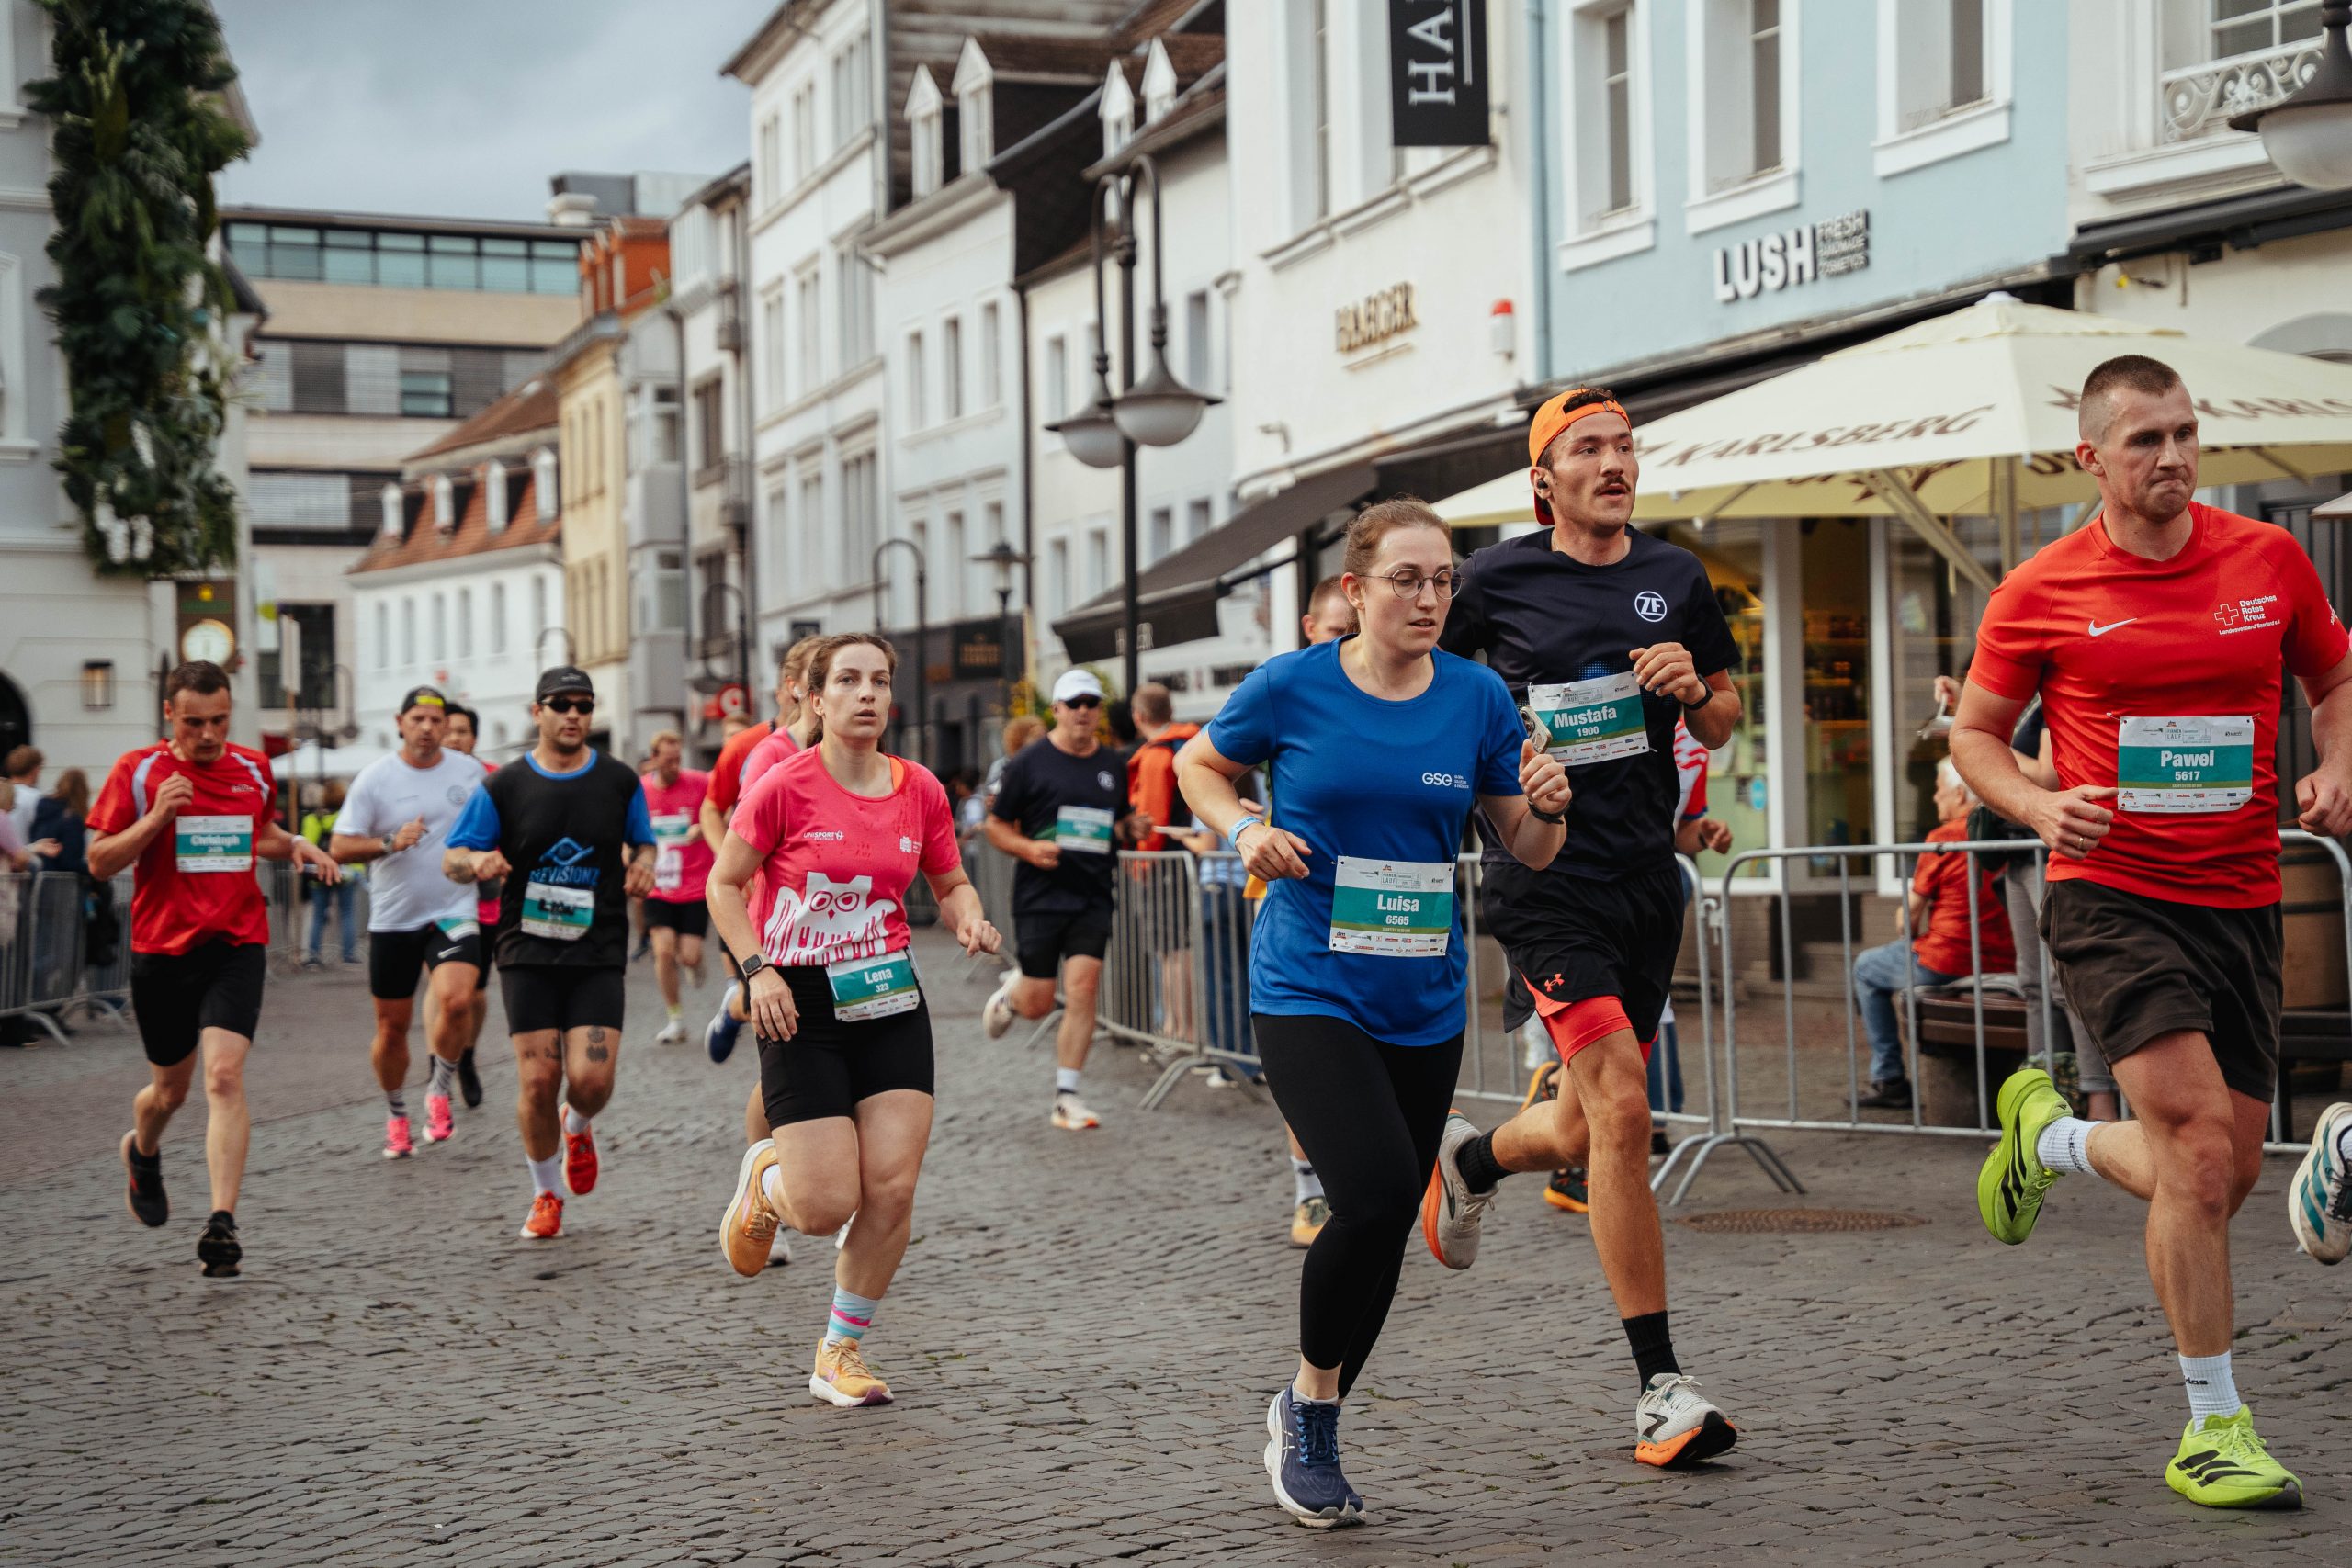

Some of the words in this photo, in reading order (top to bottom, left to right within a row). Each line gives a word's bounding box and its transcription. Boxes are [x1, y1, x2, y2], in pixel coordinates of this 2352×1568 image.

[1406, 0, 1455, 106] HA
[1713, 224, 1817, 303] LUSH
[1655, 403, 1996, 467] KARLSBERG
[1636, 595, 1665, 616] ZF
[2239, 595, 2278, 607] Deutsches
[2242, 606, 2264, 615] Rotes
[2244, 614, 2266, 622] Kreuz
[1554, 705, 1617, 728] Mustafa
[1577, 726, 1600, 737] 1900
[2161, 750, 2214, 767] Pawel
[2175, 771, 2200, 781] 5617
[1377, 894, 1419, 912] Luisa
[1385, 914, 1409, 925] 6565
[864, 967, 894, 985] Lena
[875, 982, 889, 993] 323
